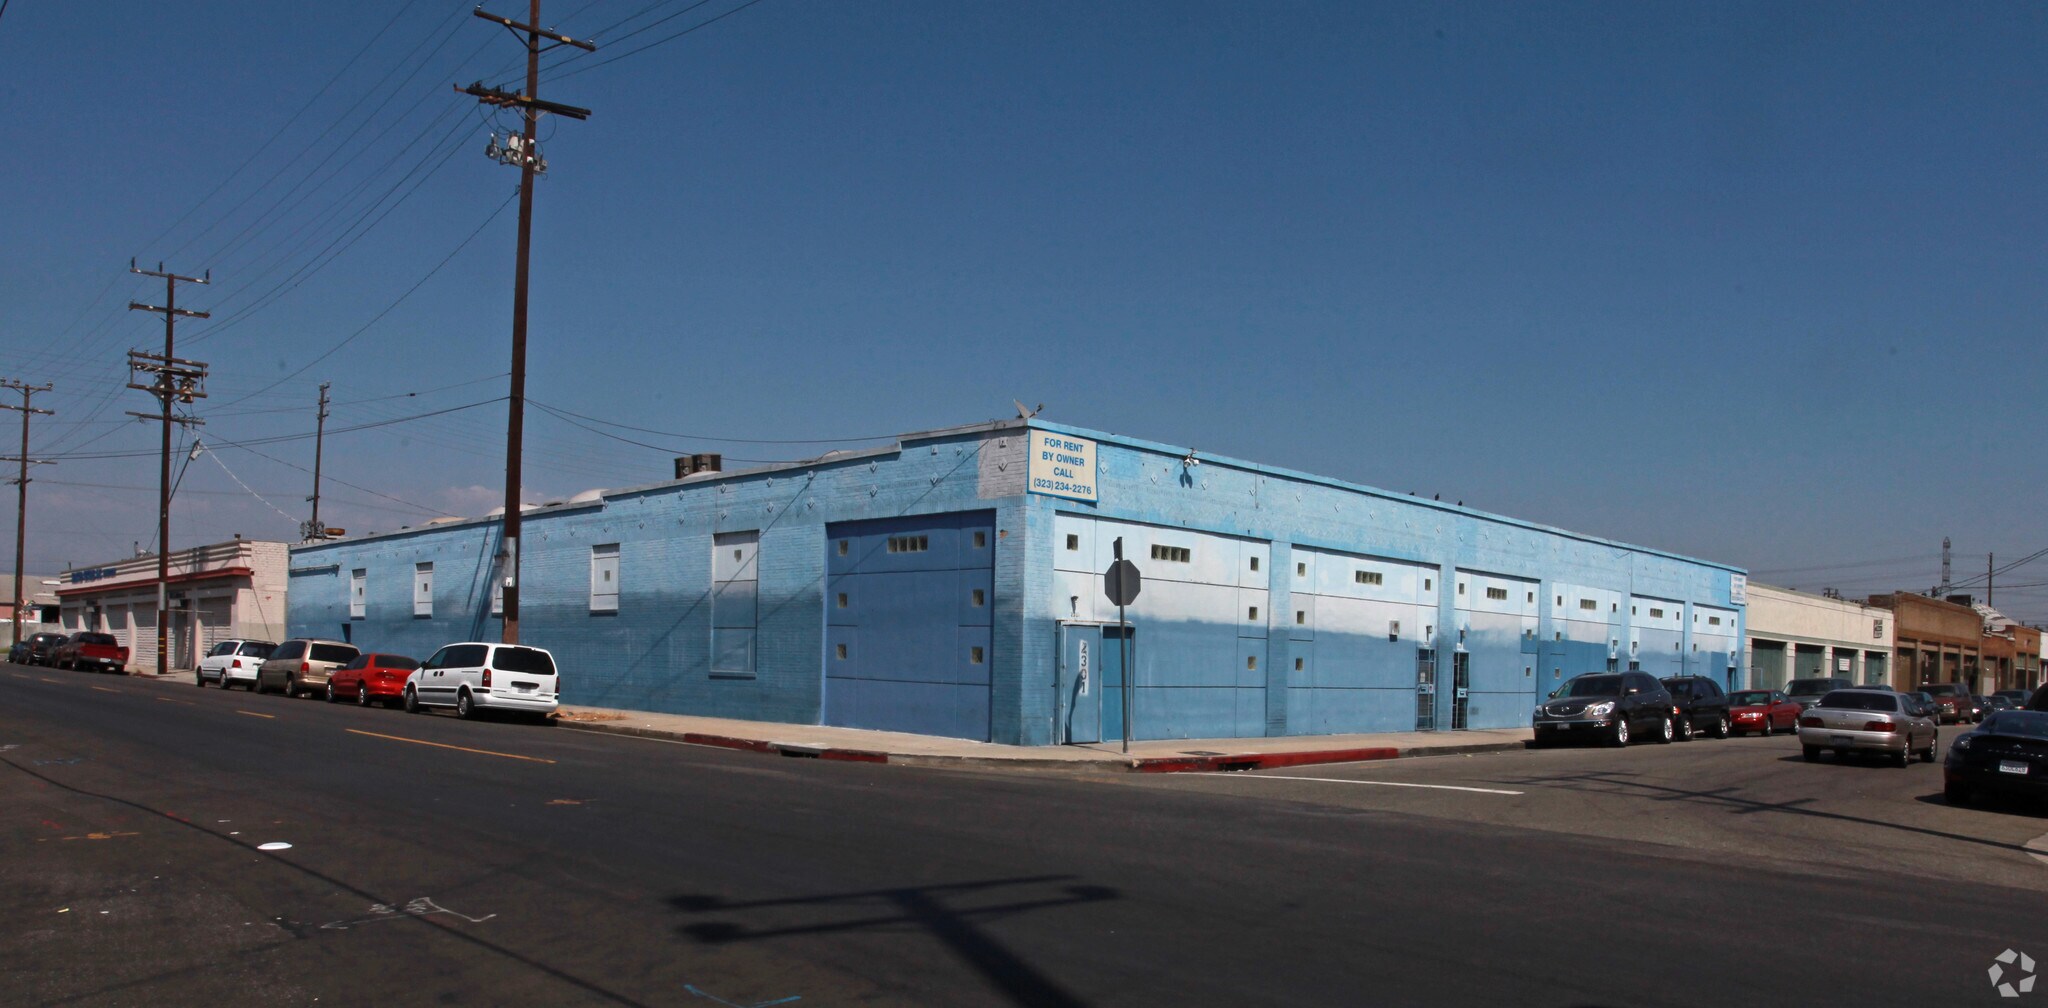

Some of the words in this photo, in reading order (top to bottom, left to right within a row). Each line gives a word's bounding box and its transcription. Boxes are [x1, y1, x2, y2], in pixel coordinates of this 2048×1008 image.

[1044, 438, 1061, 448] FOR
[1063, 441, 1084, 453] RENT
[1042, 451, 1054, 461] BY
[1056, 453, 1085, 467] OWNER
[1053, 467, 1074, 479] CALL
[1034, 478, 1053, 490] (323)
[1055, 481, 1092, 495] 234-2276
